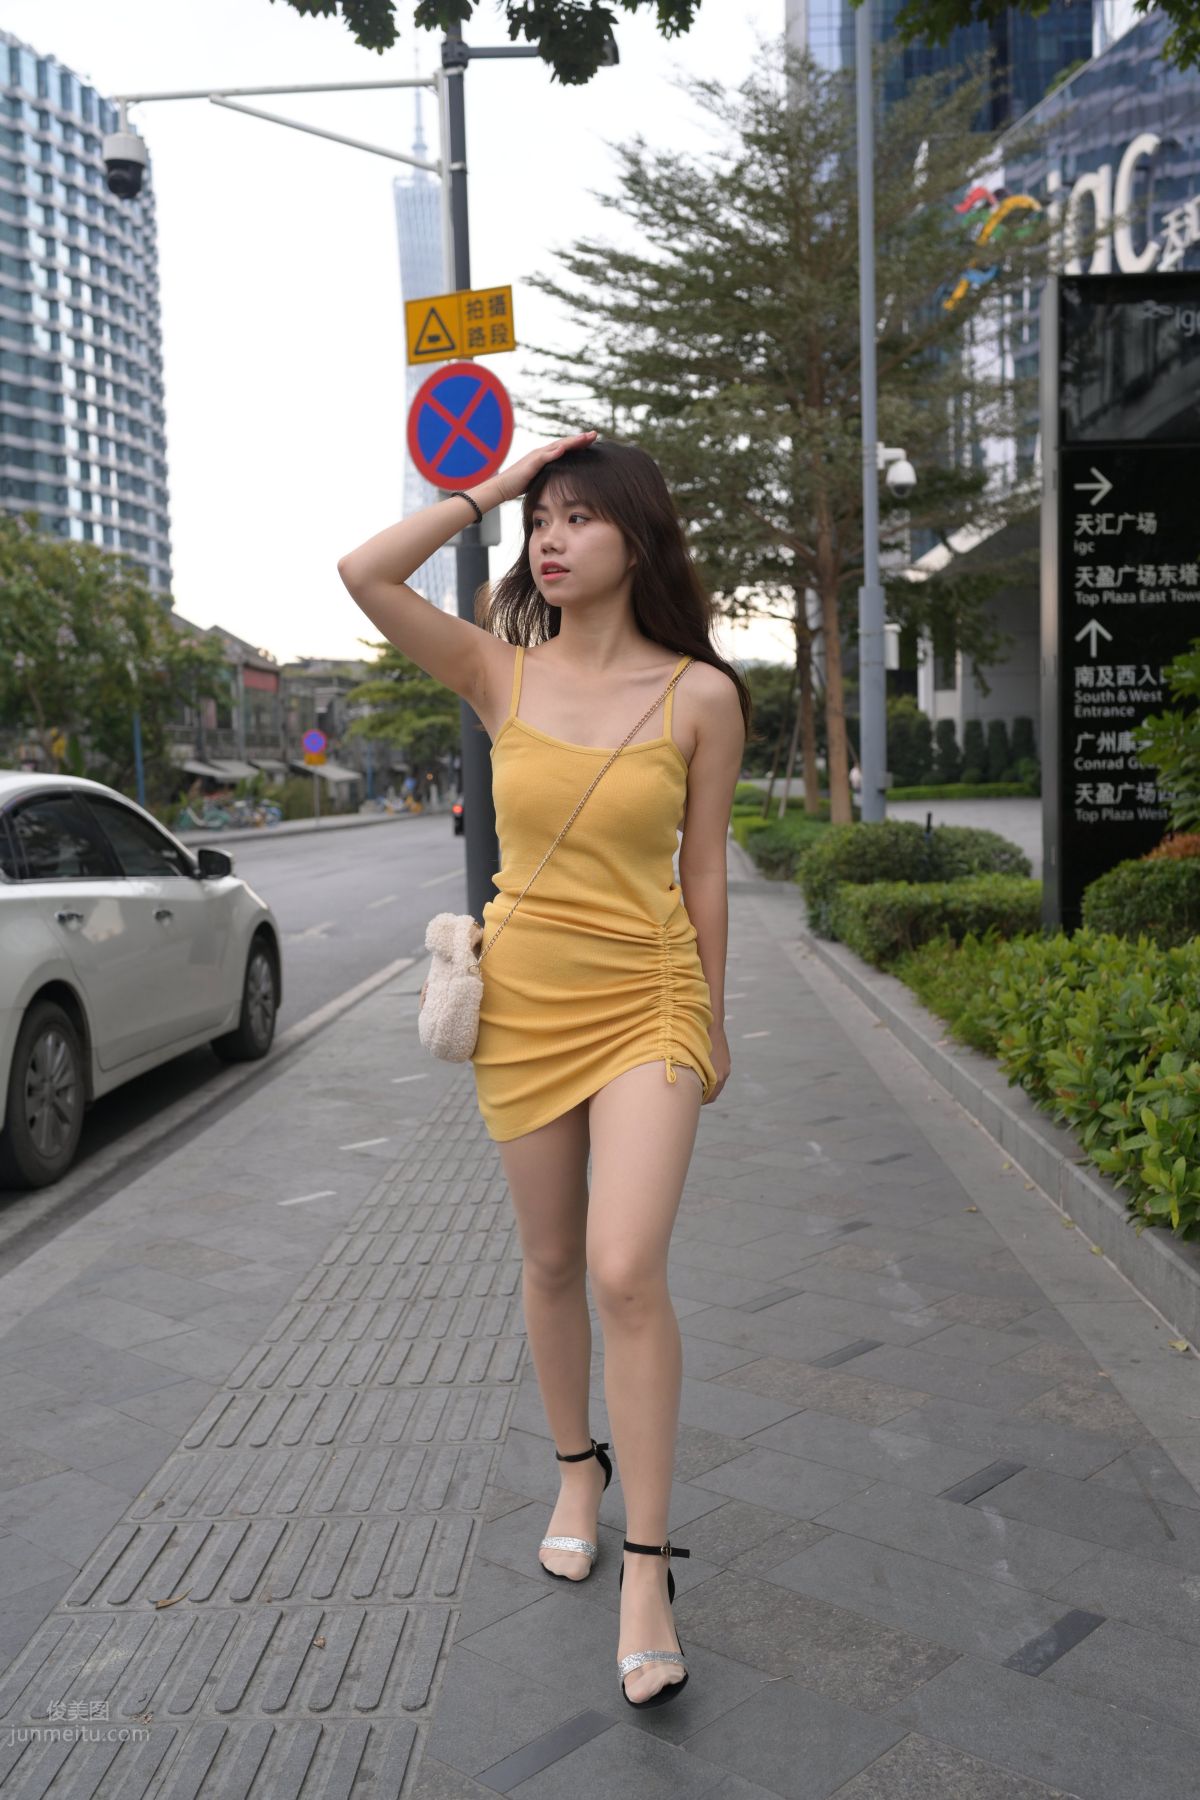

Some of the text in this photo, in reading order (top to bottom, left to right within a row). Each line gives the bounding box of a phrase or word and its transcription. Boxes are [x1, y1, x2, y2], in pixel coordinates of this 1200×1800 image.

[466, 294, 506, 321] 拍摄
[468, 322, 508, 348] 路段
[1075, 512, 1158, 536] 天汇广场
[1074, 539, 1095, 556] igc
[1075, 563, 1200, 588] 天盈广场东塔
[1075, 590, 1100, 607] Top
[1102, 590, 1137, 604] Plaza
[1139, 588, 1167, 603] East
[1074, 689, 1162, 704] South & West
[1074, 704, 1135, 718] Entrance
[1074, 756, 1124, 771] Conrad
[1075, 807, 1168, 823] Top Plaza West
